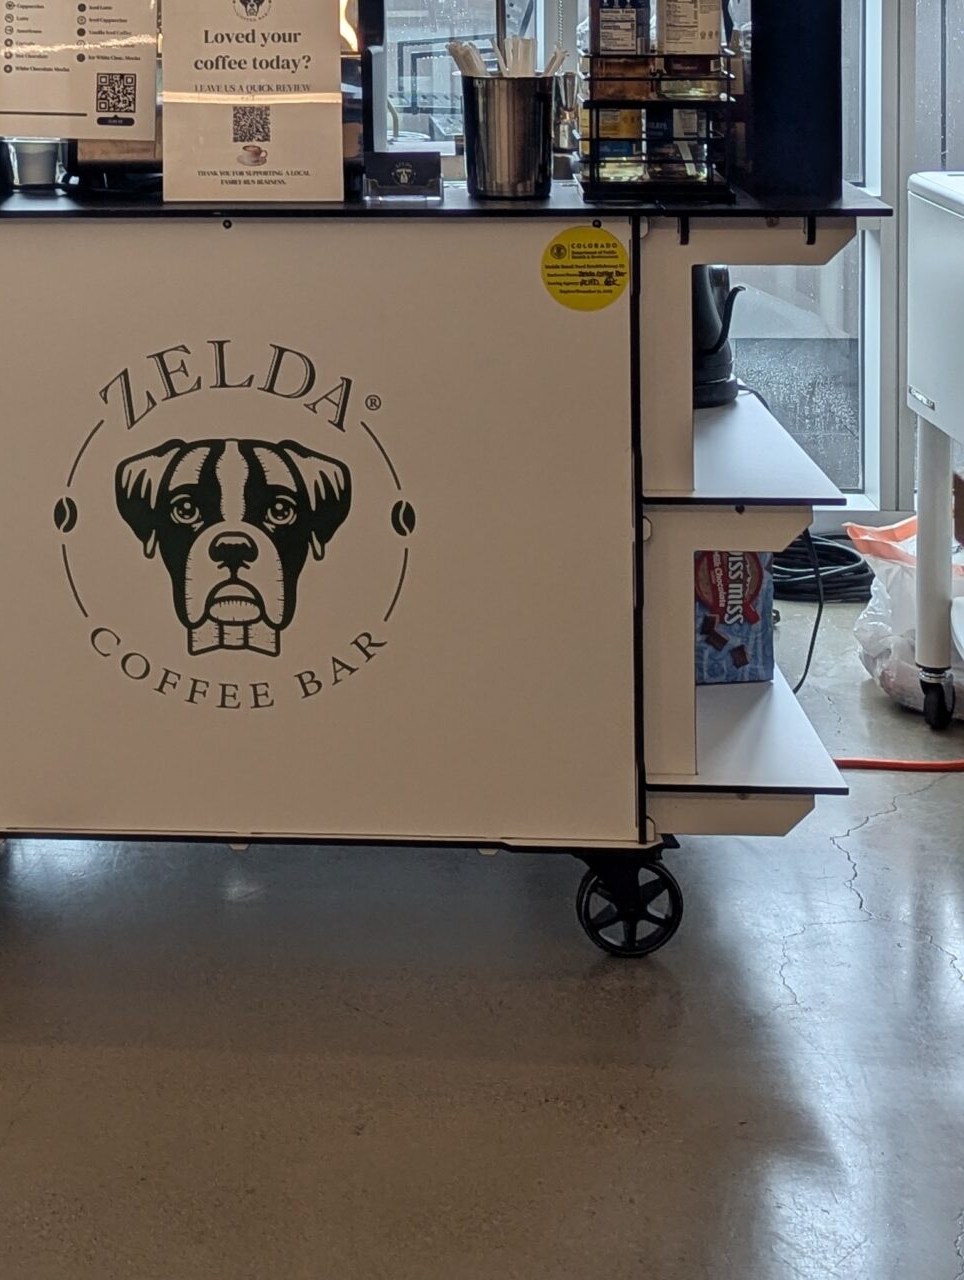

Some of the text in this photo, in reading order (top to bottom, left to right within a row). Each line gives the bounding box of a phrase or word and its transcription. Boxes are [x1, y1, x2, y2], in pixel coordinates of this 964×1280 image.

[204, 29, 302, 47] Loved your
[194, 55, 312, 74] coffee today?
[195, 84, 312, 94] LEAVE US A QUICK REVIEW
[715, 567, 727, 608] Chocolate
[90, 626, 389, 710] COFFEE BAR
